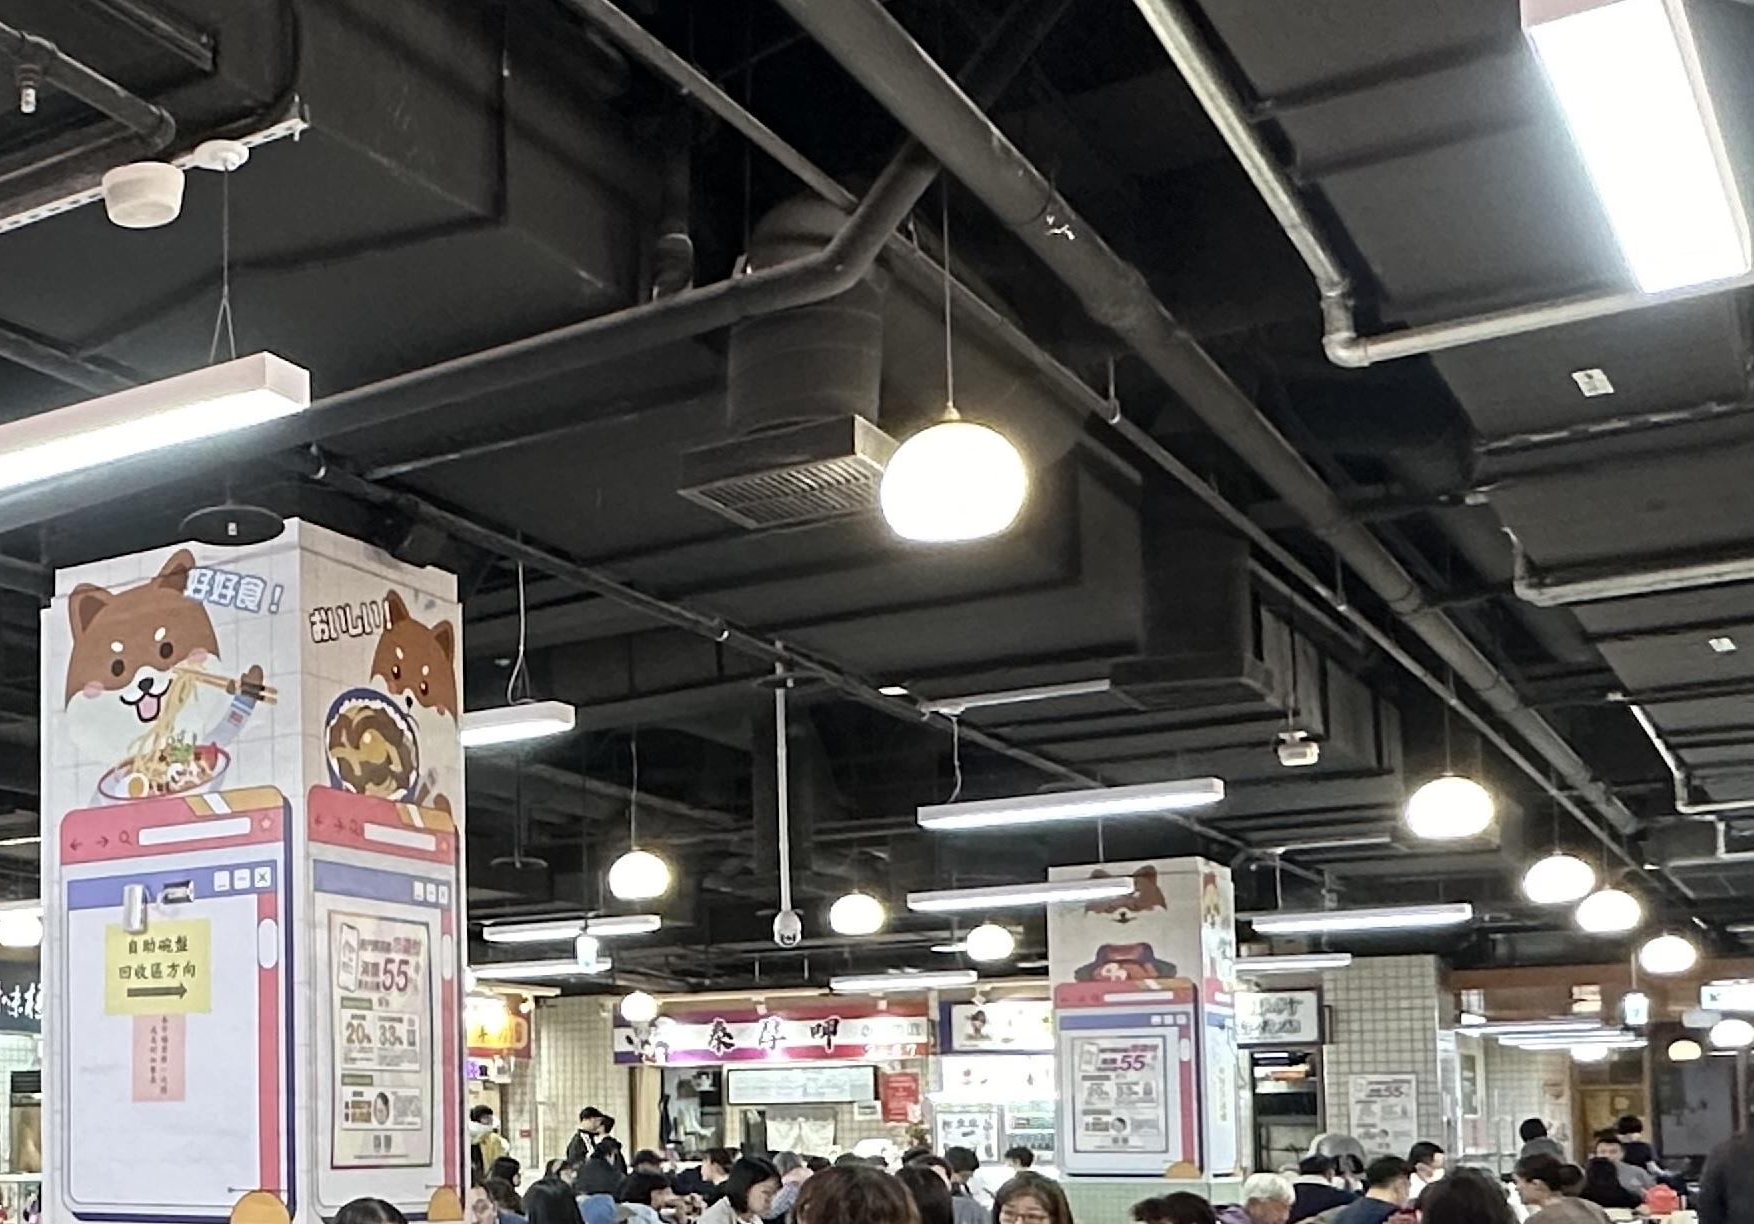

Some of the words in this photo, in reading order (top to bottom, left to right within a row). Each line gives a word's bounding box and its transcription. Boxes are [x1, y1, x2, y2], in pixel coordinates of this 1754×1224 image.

[128, 935, 188, 954] 自助碗盤
[119, 960, 196, 979] 回收區方向
[382, 957, 409, 992] 55
